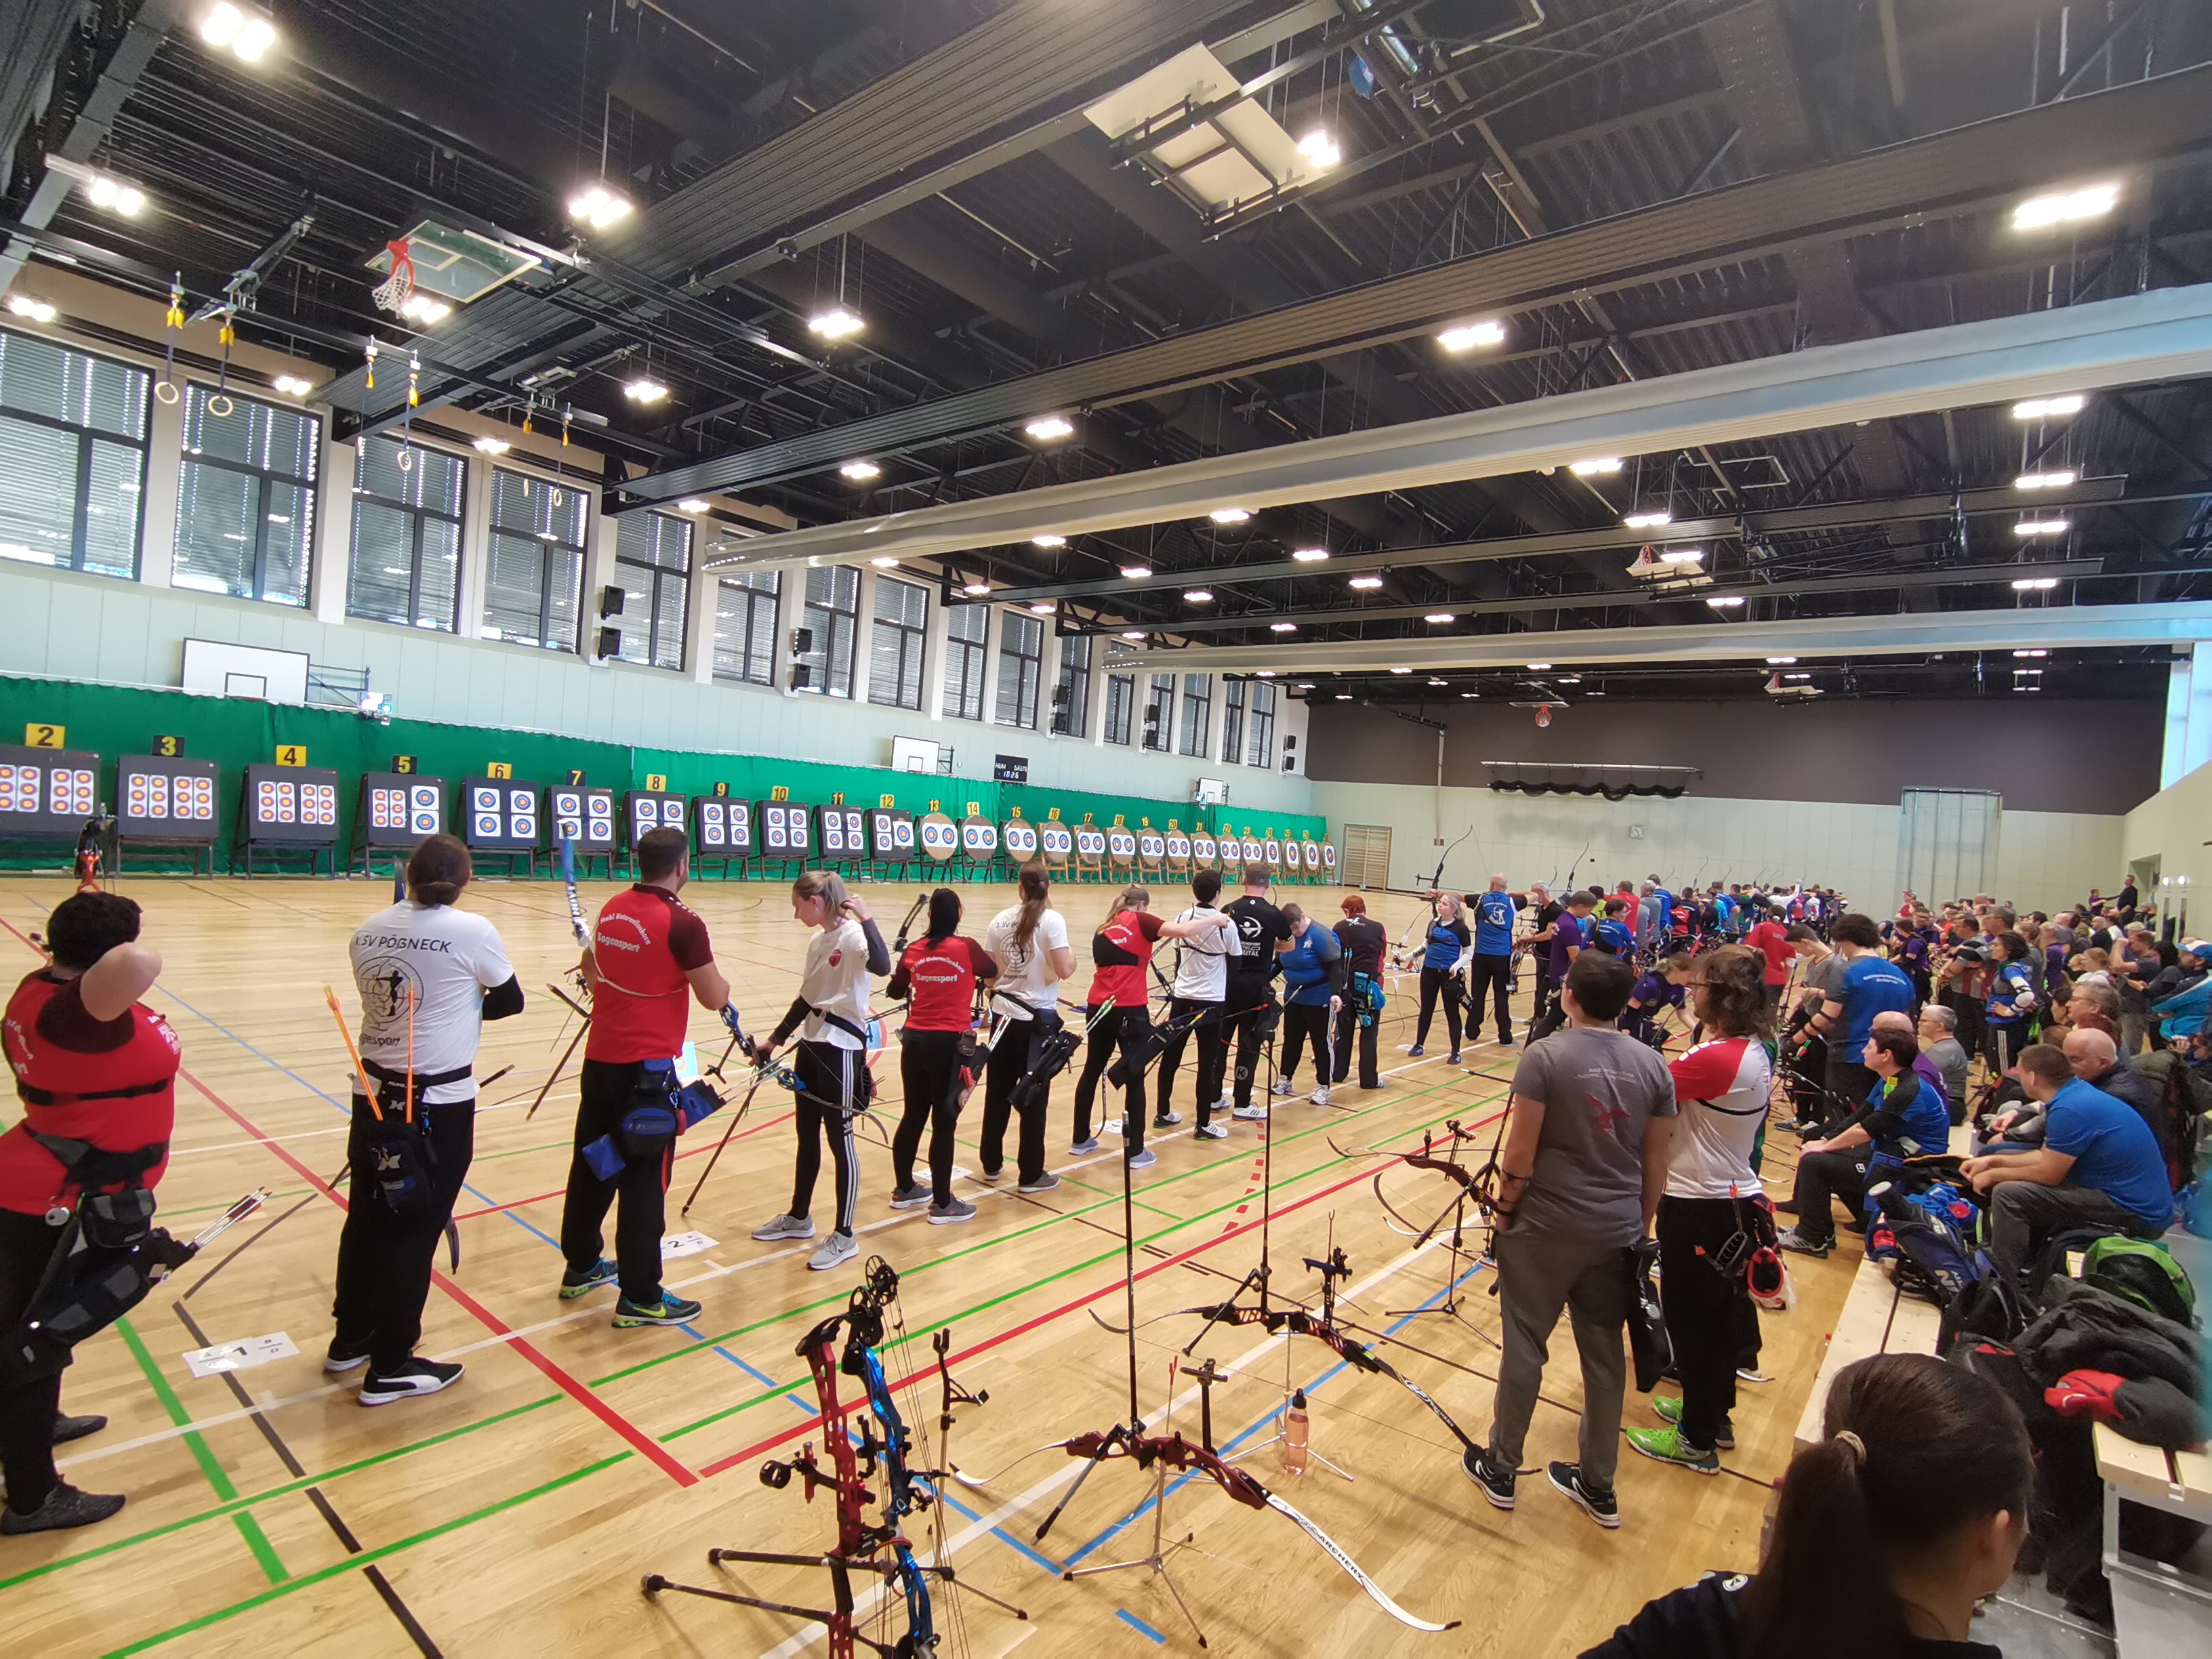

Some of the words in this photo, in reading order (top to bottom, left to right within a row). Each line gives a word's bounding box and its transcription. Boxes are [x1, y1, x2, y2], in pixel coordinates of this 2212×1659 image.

[37, 726, 54, 746] 2
[160, 736, 176, 756] 3
[283, 747, 297, 765] 4
[398, 756, 411, 773] 5
[495, 764, 504, 779] 6
[571, 770, 582, 785] 7
[652, 776, 660, 790] 8
[717, 782, 726, 797] 9
[775, 788, 787, 800] 10
[832, 793, 845, 805] 11
[881, 796, 893, 807] 12
[929, 800, 940, 812] 13
[968, 803, 978, 813] 14
[1012, 806, 1021, 818] 15
[1050, 808, 1059, 819] 16
[1084, 813, 1093, 823] 17
[1115, 815, 1124, 825] 18
[1142, 817, 1149, 827] 19
[667, 1240, 685, 1248] 2
[1317, 1534, 1364, 1579] ARCHERY
